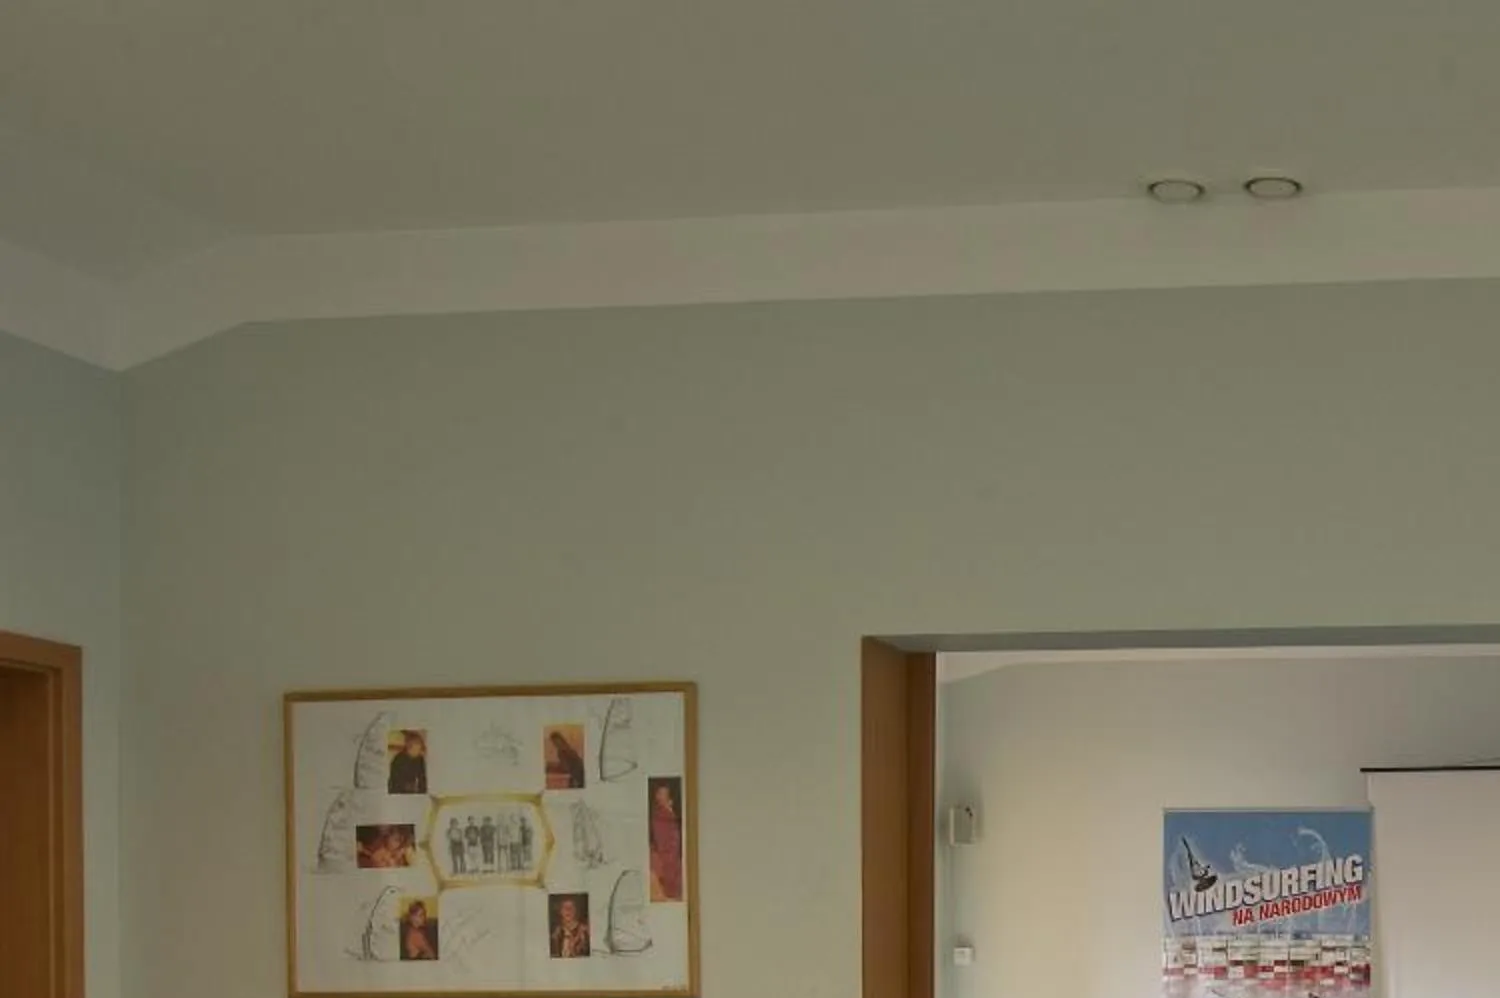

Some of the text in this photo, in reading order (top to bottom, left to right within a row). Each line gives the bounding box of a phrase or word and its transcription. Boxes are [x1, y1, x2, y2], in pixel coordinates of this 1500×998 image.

[1167, 854, 1364, 923] WINDSURFING
[1231, 885, 1362, 927] NA NARODOWYM
